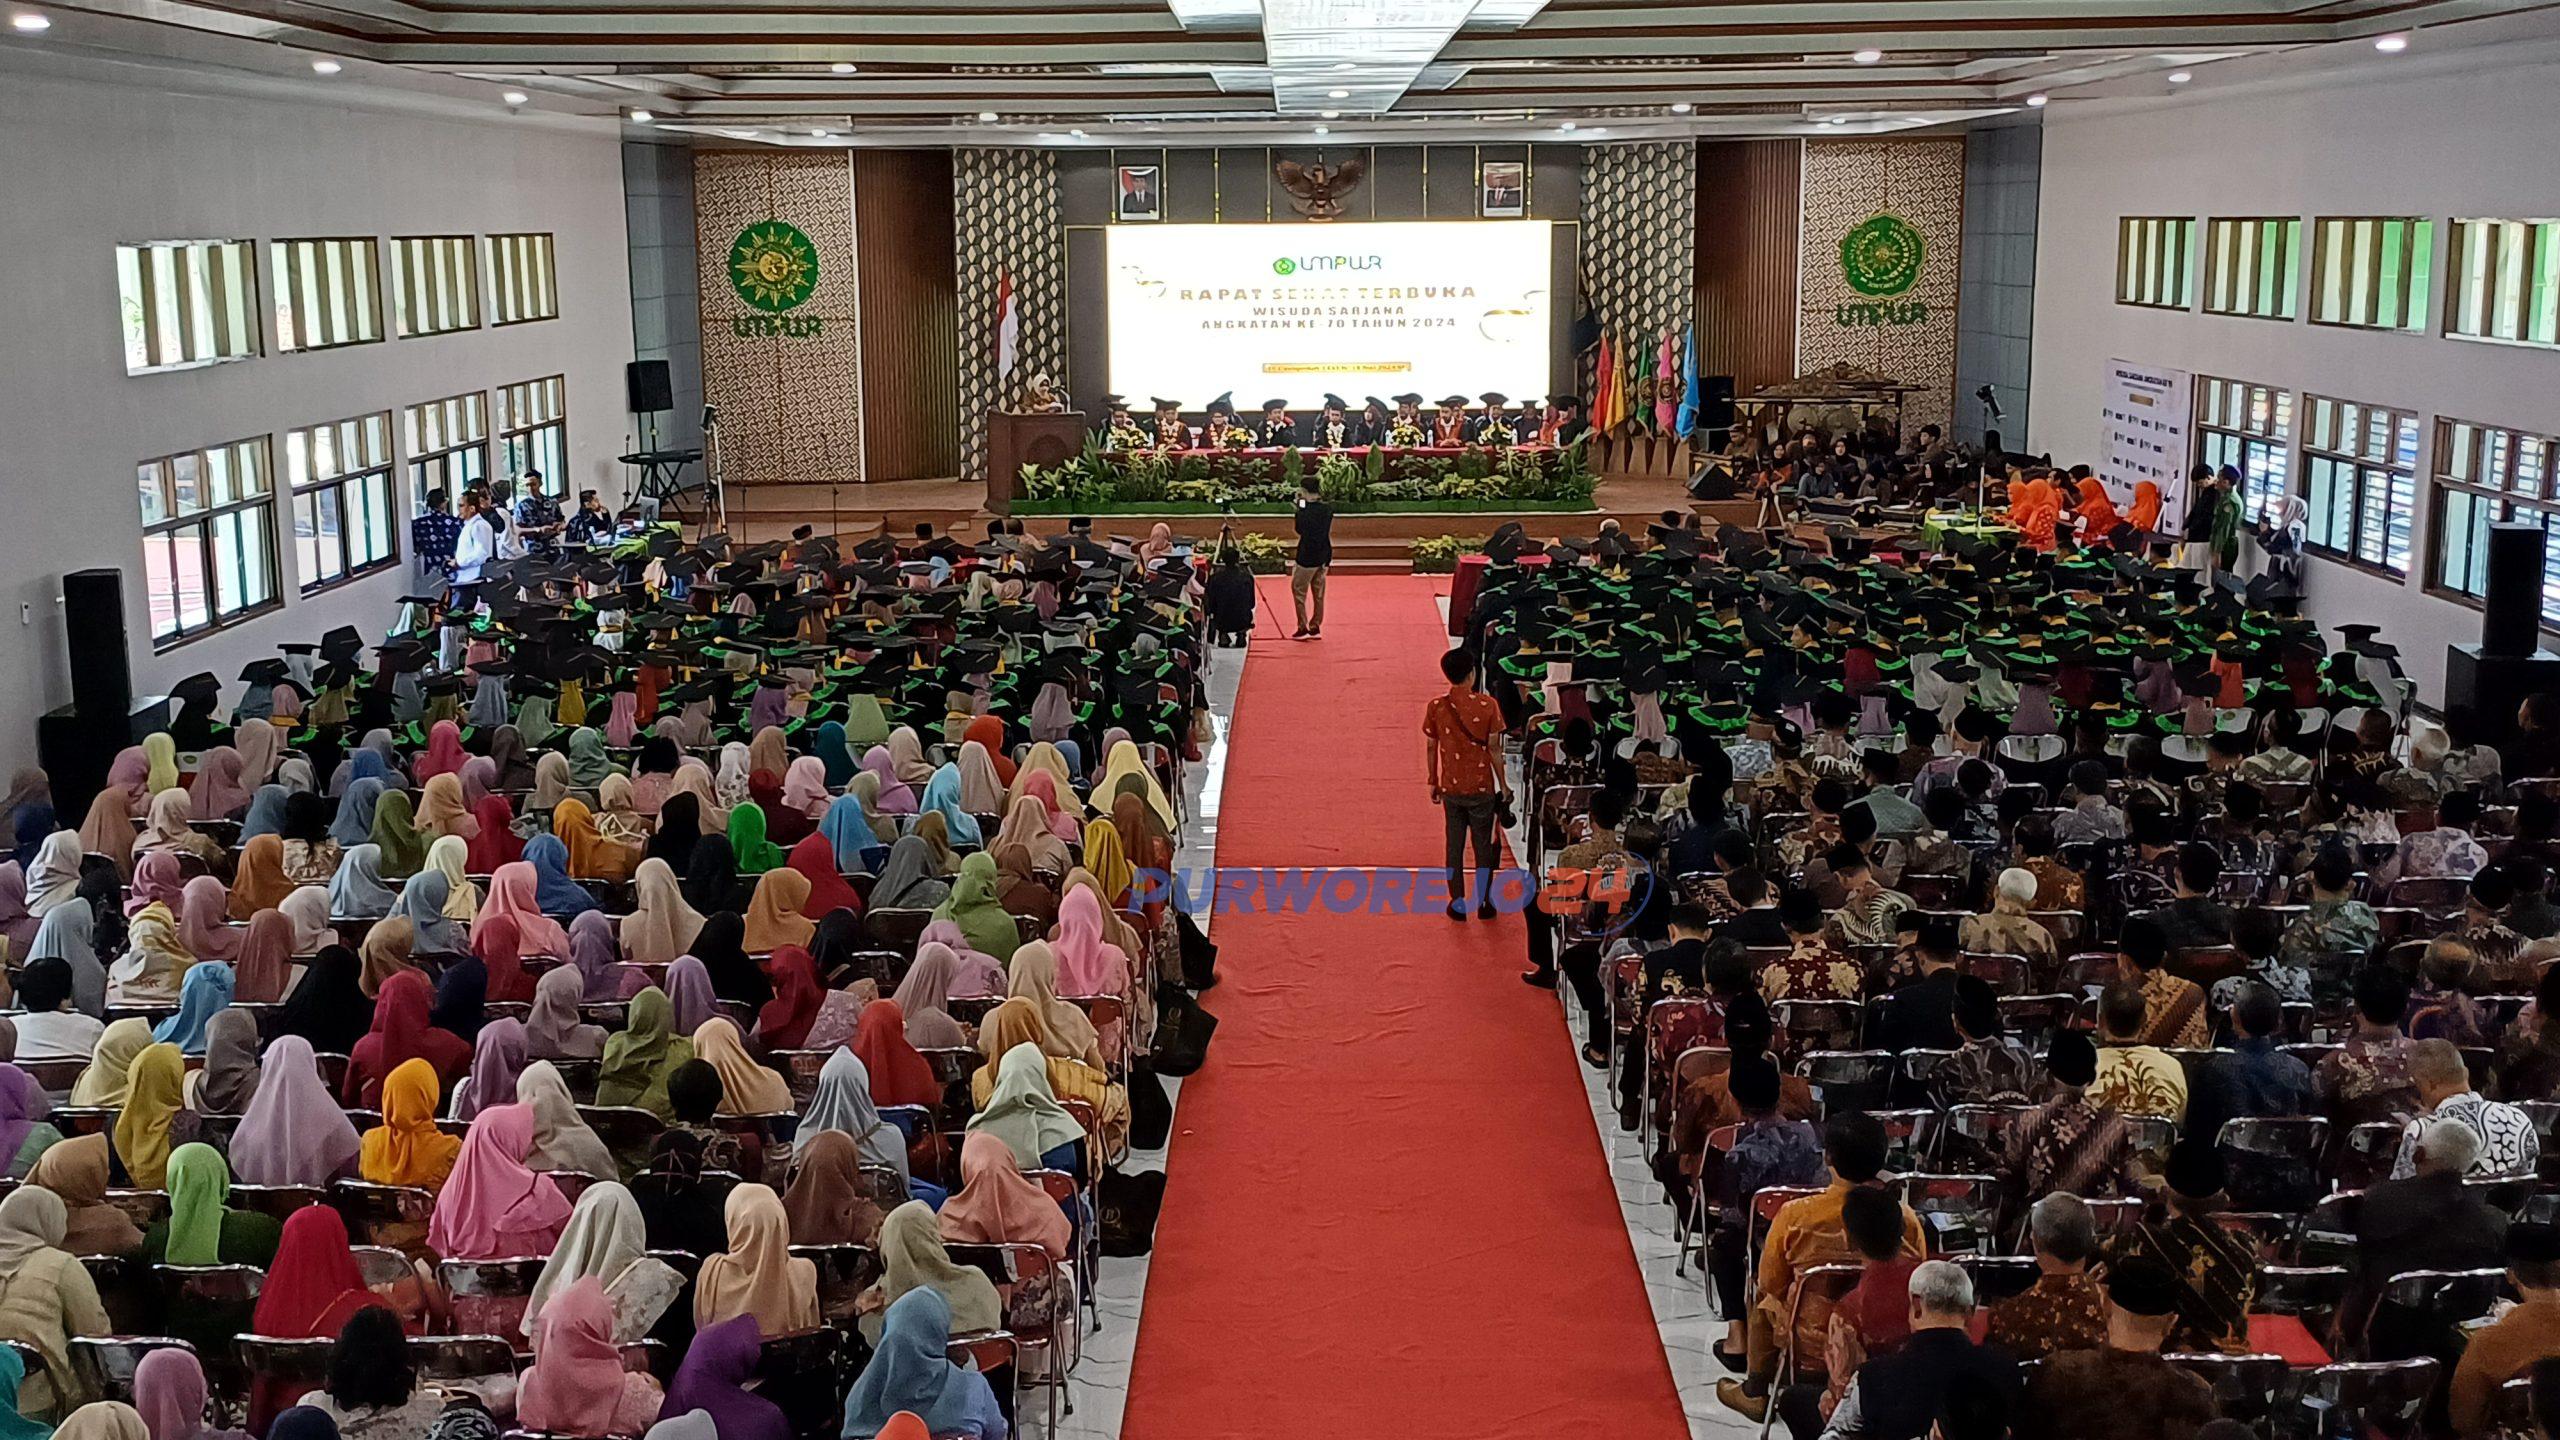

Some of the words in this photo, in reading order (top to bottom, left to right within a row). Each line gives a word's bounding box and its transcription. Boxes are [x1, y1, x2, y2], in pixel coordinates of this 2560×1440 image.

[1179, 287, 1262, 301] RAPAT
[1357, 286, 1476, 300] TERBUKA
[1252, 306, 1323, 317] WISUDA
[1327, 305, 1405, 316] SARJANA
[1201, 319, 1291, 330] ANGKATAN
[1351, 318, 1407, 329] TAHUN
[1412, 317, 1456, 328] 2024
